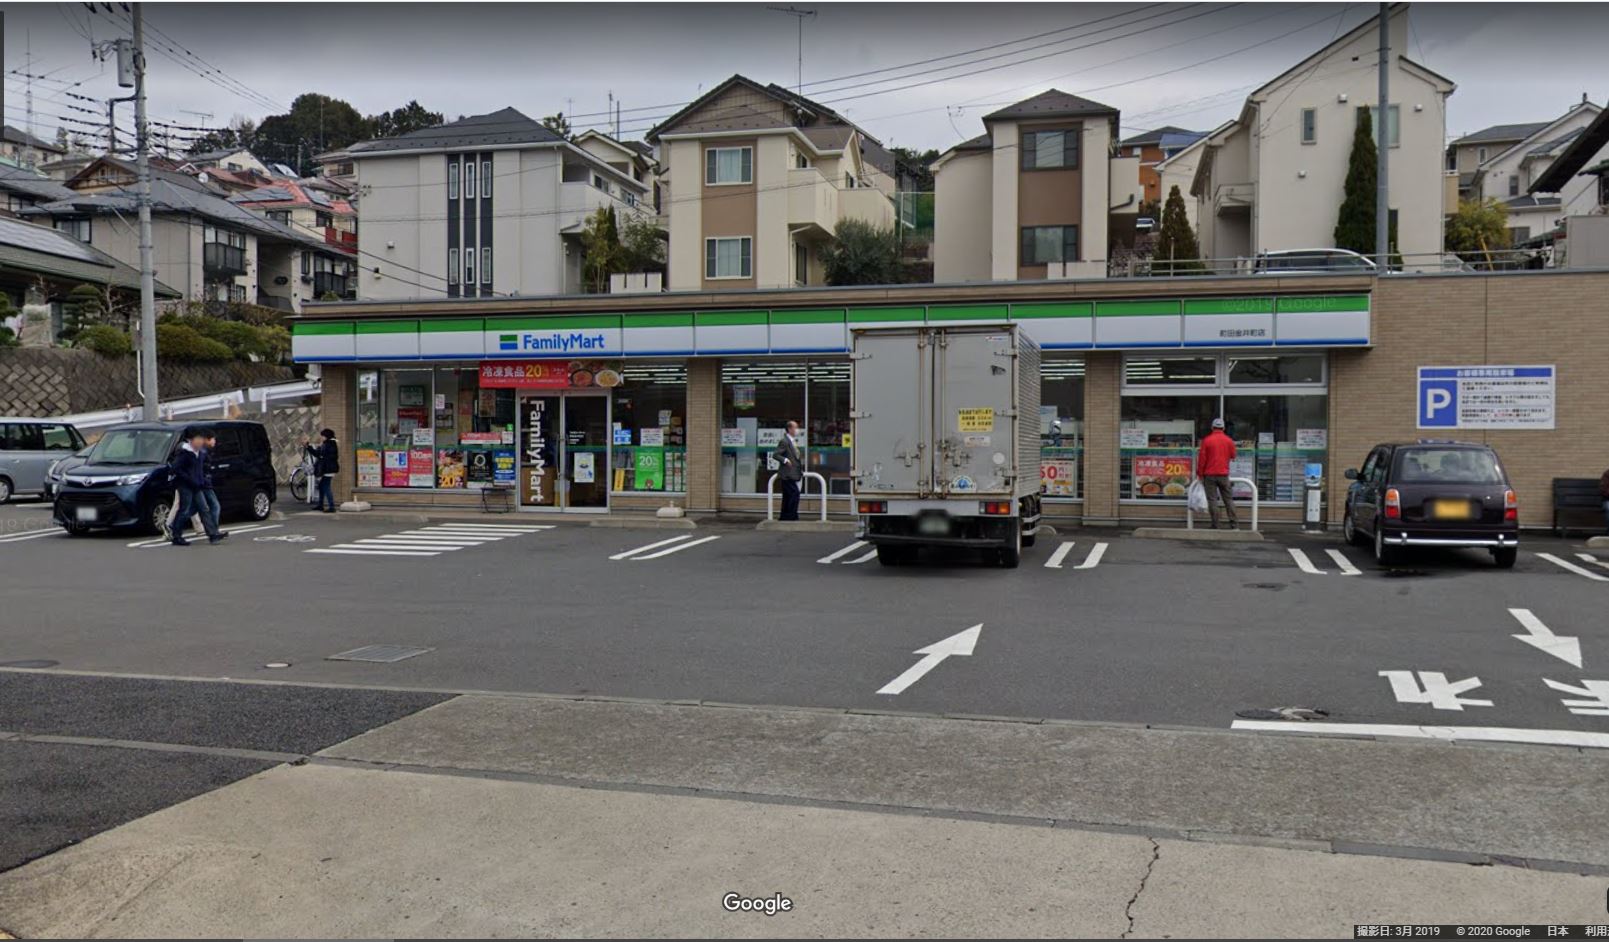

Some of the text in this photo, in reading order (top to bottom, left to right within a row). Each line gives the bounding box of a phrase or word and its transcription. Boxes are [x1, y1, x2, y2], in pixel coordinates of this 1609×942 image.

[523, 333, 605, 351] FamilyMart
[1219, 329, 1266, 337] 町田金井町店
[482, 366, 525, 377] 冷凍食品
[1426, 388, 1452, 419] P
[527, 400, 545, 502] FamilyMart
